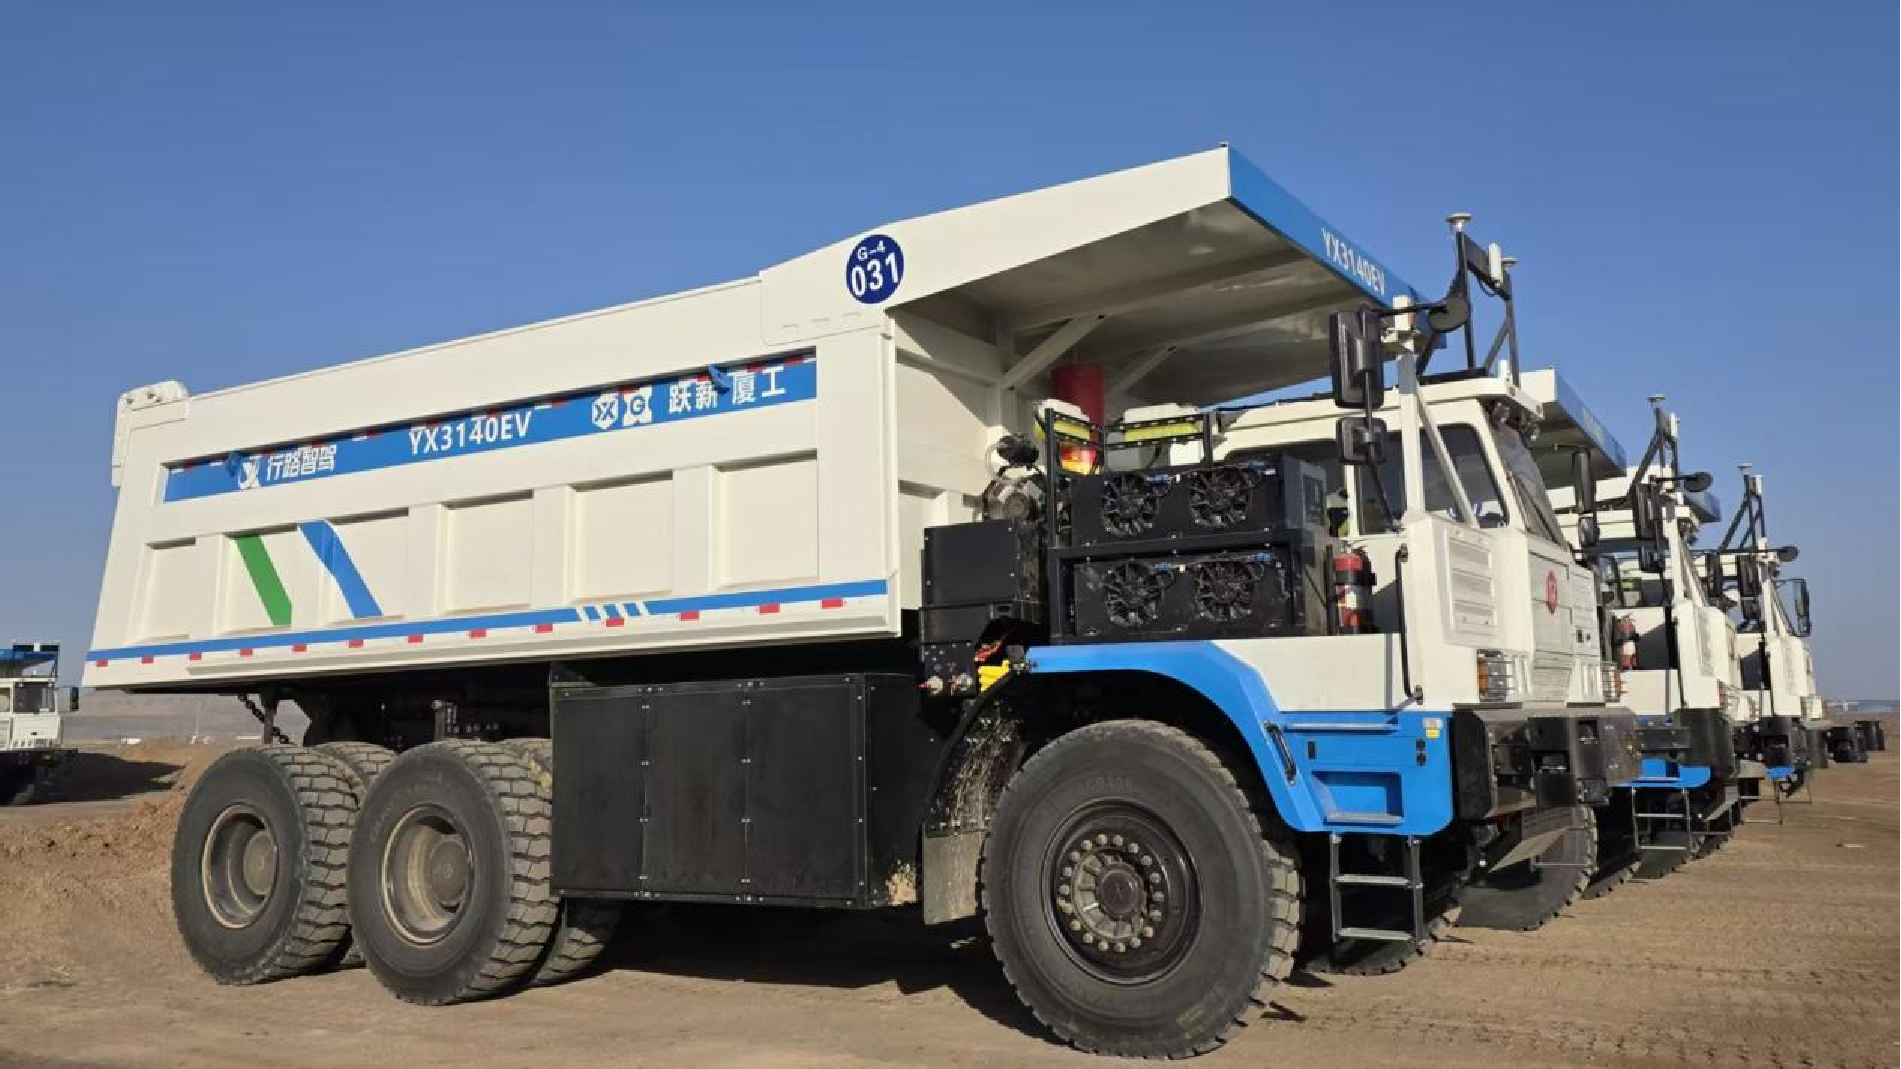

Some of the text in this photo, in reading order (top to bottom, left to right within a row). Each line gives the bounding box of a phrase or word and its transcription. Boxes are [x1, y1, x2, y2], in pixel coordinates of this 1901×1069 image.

[857, 240, 886, 260] G-4
[1320, 227, 1385, 296] YX3140EV
[851, 252, 899, 297] 031
[408, 409, 532, 455] YX3140EV
